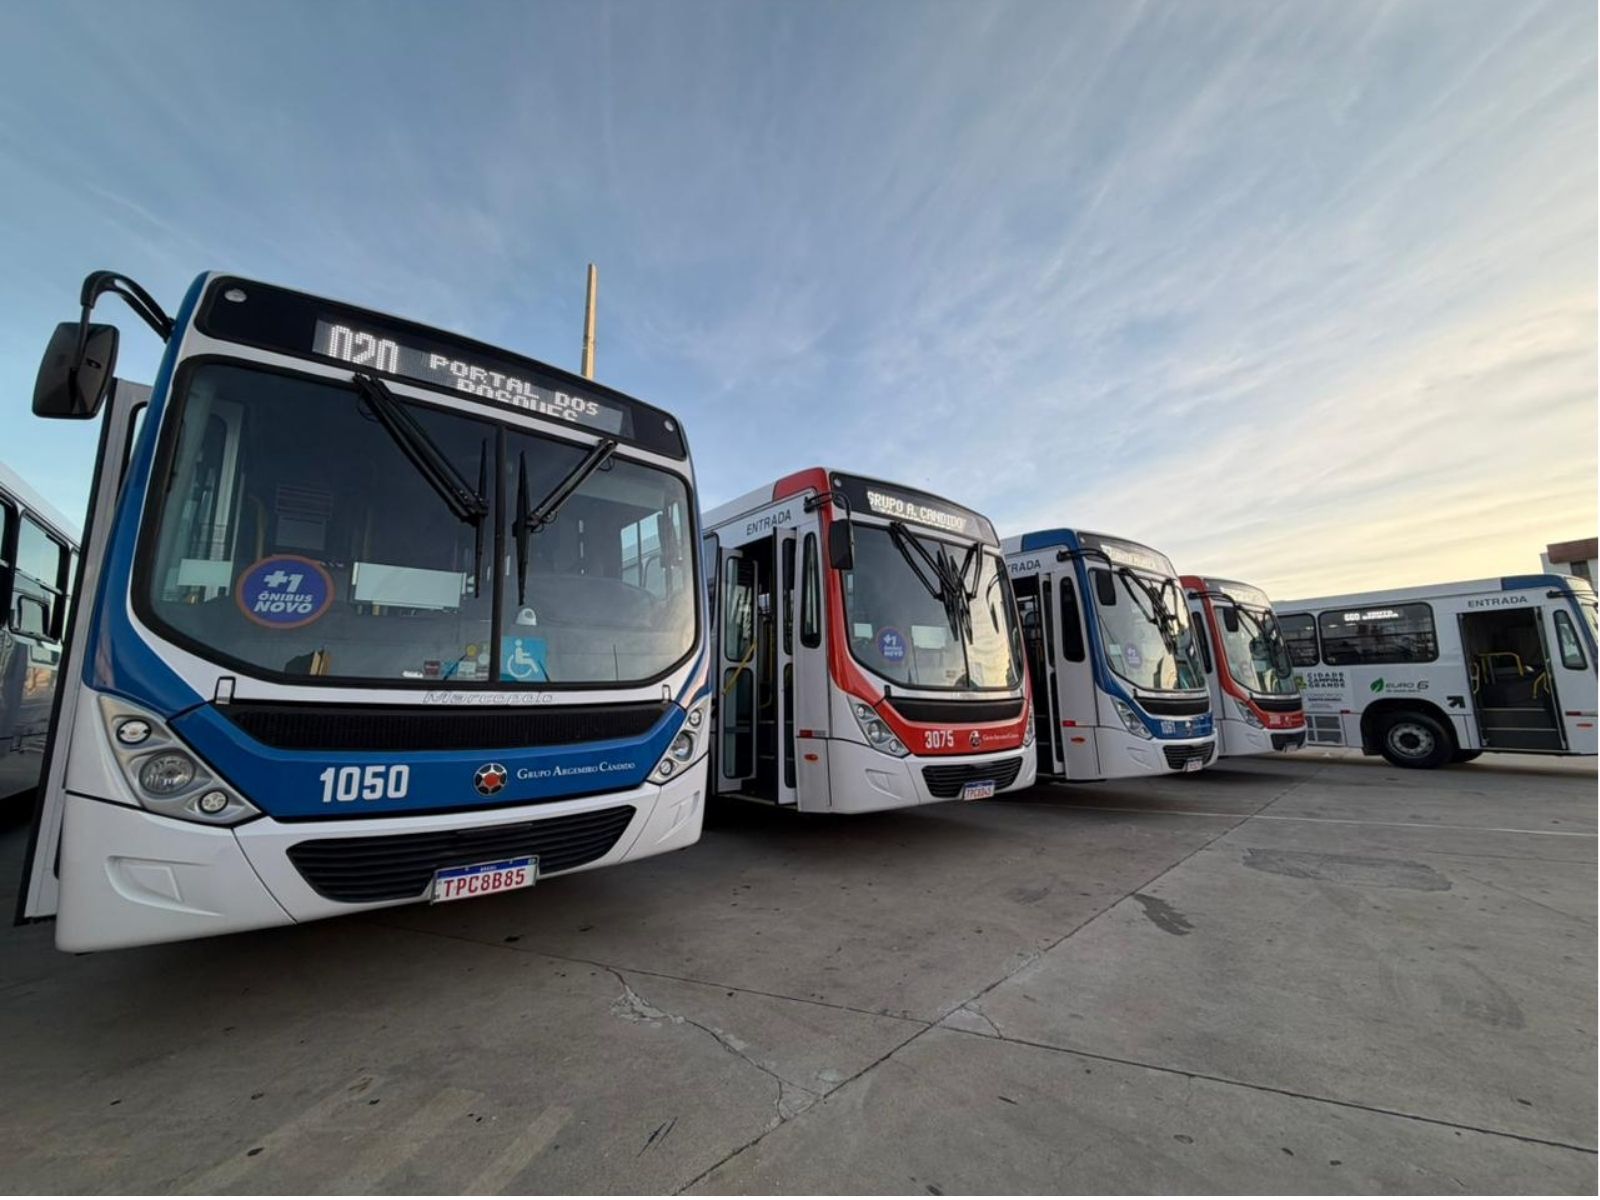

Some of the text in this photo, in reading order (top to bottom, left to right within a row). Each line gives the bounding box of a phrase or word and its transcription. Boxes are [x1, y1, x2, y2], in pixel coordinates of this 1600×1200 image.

[429, 353, 540, 399] PORTAL
[554, 390, 599, 416] DOS
[746, 509, 792, 536] ENTRADA
[1007, 560, 1041, 573] RADA
[264, 570, 304, 592] +1
[254, 601, 312, 614] NOVO
[1468, 596, 1528, 608] ENTRADA
[1417, 680, 1429, 690] 6
[924, 730, 955, 749] 3075
[320, 764, 410, 803] 1050
[444, 868, 526, 897] TPC8B85
